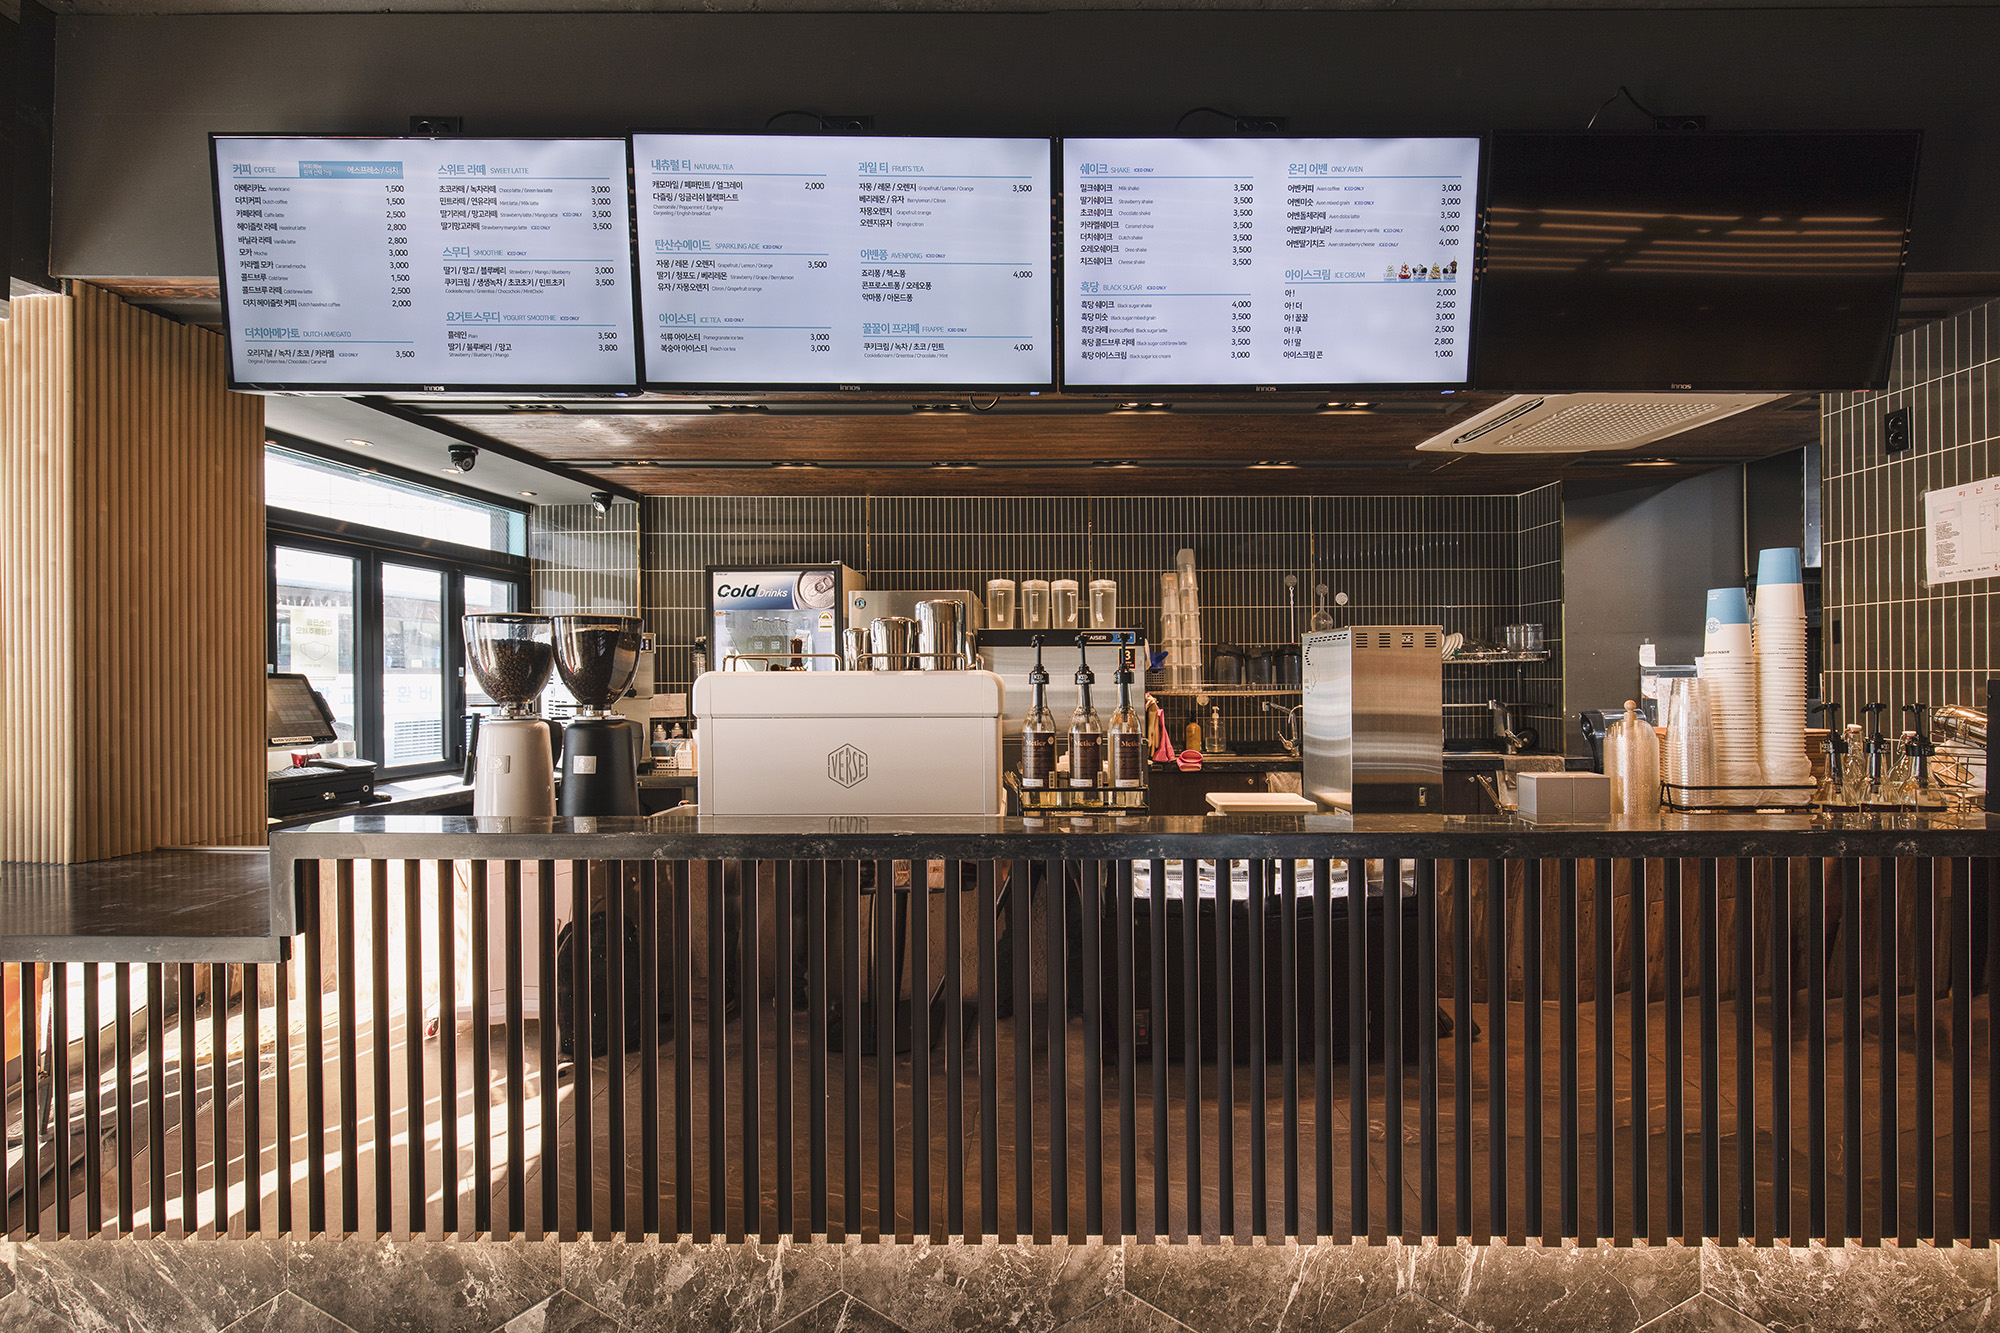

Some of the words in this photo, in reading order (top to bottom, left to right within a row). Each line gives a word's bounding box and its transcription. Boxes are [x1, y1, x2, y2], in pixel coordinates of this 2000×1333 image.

[651, 159, 680, 171] 내츄럴
[682, 159, 691, 171] 티
[858, 162, 877, 173] 과일
[879, 162, 888, 173] 티
[1080, 163, 1108, 175] 쉐이크
[1288, 163, 1307, 175] 온리
[1309, 163, 1327, 175] 어벤
[233, 164, 251, 175] 커피
[438, 164, 466, 176] 스위트
[467, 164, 486, 176] 라떼
[234, 184, 267, 192] 아메리카노
[385, 185, 404, 193] 1,500
[439, 185, 465, 193] 초코라떼
[470, 185, 496, 193] 녹차라떼
[591, 186, 610, 194] 3,000
[805, 182, 824, 190] 2,000
[1013, 185, 1032, 193] 3,500
[1080, 184, 1113, 192] 밀크쉐이크
[1234, 184, 1253, 192] 3,500
[1288, 184, 1314, 193] 어벤커피
[1442, 184, 1461, 192] 3,000
[235, 196, 261, 205] 더치커피
[386, 198, 405, 206] 1,500
[592, 198, 611, 206] 3,000
[1234, 197, 1253, 205] 3,500
[1441, 198, 1461, 206] 3,000
[386, 211, 406, 219] 2,500
[592, 210, 611, 218] 3,500
[1080, 208, 1113, 217] 초코쉐이크
[1233, 209, 1253, 217] 3,500
[1441, 211, 1460, 219] 3,500
[387, 223, 406, 231] 2,800
[593, 223, 612, 231] 3,500
[860, 219, 893, 227] 오렌지유자
[1233, 222, 1252, 230] 3,500
[1439, 225, 1459, 233] 4,000
[388, 237, 407, 245] 2,800
[1233, 234, 1252, 242] 3,500
[655, 239, 711, 251] 탄산수에이드
[1439, 239, 1459, 247] 4,000
[239, 248, 252, 256] 모카
[389, 249, 408, 257] 3,000
[442, 246, 470, 258] 스무디
[1233, 246, 1252, 254] 3,500
[860, 249, 888, 261] 어벤퐁
[261, 261, 274, 269] 모카
[656, 260, 670, 268] 자몽
[675, 260, 689, 268] 레몬
[695, 260, 715, 268] 오렌지
[808, 261, 827, 269] 3,500
[1080, 257, 1113, 265] 치즈쉐이크
[1232, 258, 1252, 266] 3,500
[595, 267, 614, 275] 3,000
[1013, 271, 1033, 279] 4,000
[1285, 269, 1330, 280] 아이스크림
[241, 273, 267, 282] 콜드브루
[391, 274, 410, 282] 1,500
[596, 279, 615, 287] 3,500
[1080, 281, 1100, 293] 흑당
[391, 287, 411, 295] 2,500
[1437, 289, 1456, 297] 2,000
[392, 300, 411, 308] 2,000
[1081, 301, 1094, 309] 흑당
[1095, 301, 1115, 309] 쉐이크
[1436, 301, 1456, 309] 2,500
[446, 311, 500, 323] 요거트스무디
[659, 313, 696, 324] 아이스티
[1232, 313, 1251, 321] 3,500
[1436, 313, 1455, 321] 3,000
[862, 323, 890, 334] 꿀꿀이
[892, 323, 920, 334] 프라페
[1435, 325, 1454, 333] 2,500
[245, 327, 300, 339] 더치아메가토
[448, 331, 467, 339] 플레인
[598, 332, 617, 340] 3,500
[810, 333, 829, 341] 3,000
[1232, 338, 1251, 346] 3,500
[1434, 338, 1454, 346] 2,800
[599, 344, 618, 352] 3,800
[661, 344, 680, 353] 복숭아
[681, 344, 707, 352] 아이스티
[1014, 344, 1033, 352] 4,000
[1231, 351, 1250, 359] 3,000
[1283, 351, 1315, 359] 아이스크림
[1316, 351, 1323, 359] 콘
[1435, 350, 1453, 358] 1,000
[717, 584, 760, 598] Cold
[757, 589, 788, 598] Drinks
[1125, 650, 1131, 660] 3
[831, 747, 865, 785] VERSE
